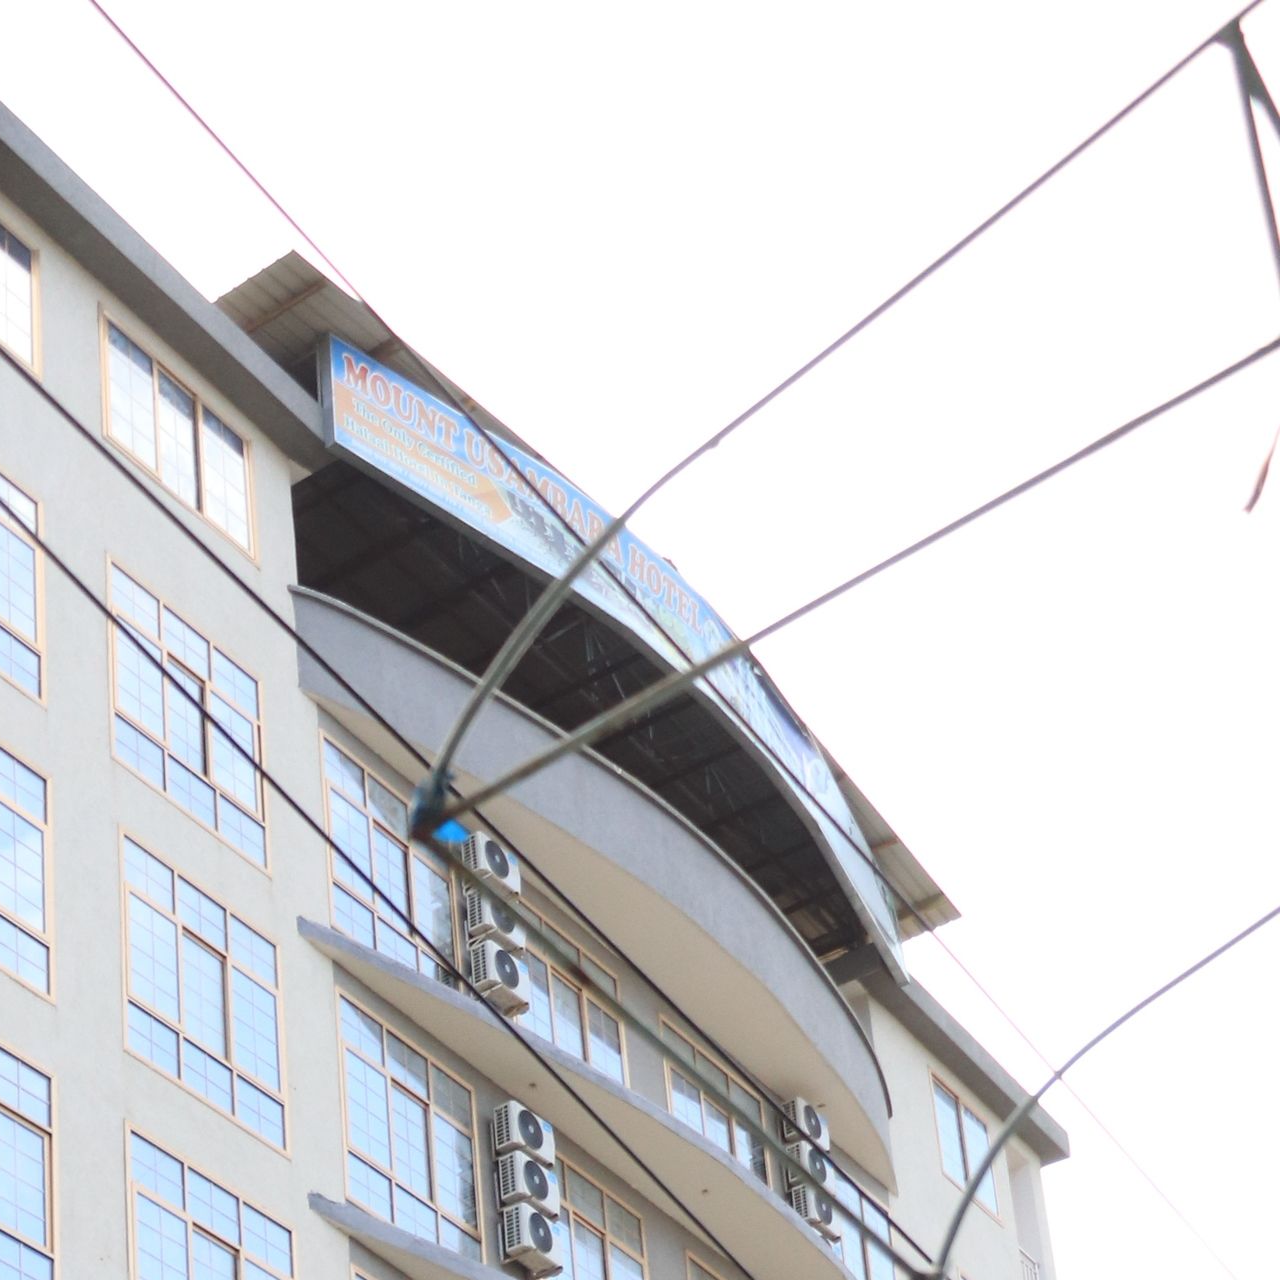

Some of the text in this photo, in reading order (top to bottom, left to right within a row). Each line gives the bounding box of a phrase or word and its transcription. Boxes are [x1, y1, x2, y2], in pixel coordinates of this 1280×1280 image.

[342, 353, 460, 451] MOUNT
[463, 426, 624, 564] USAMBARA
[628, 543, 705, 635] HOTEL
[352, 398, 381, 424] The
[383, 418, 415, 450] Only
[416, 439, 478, 487] Certified
